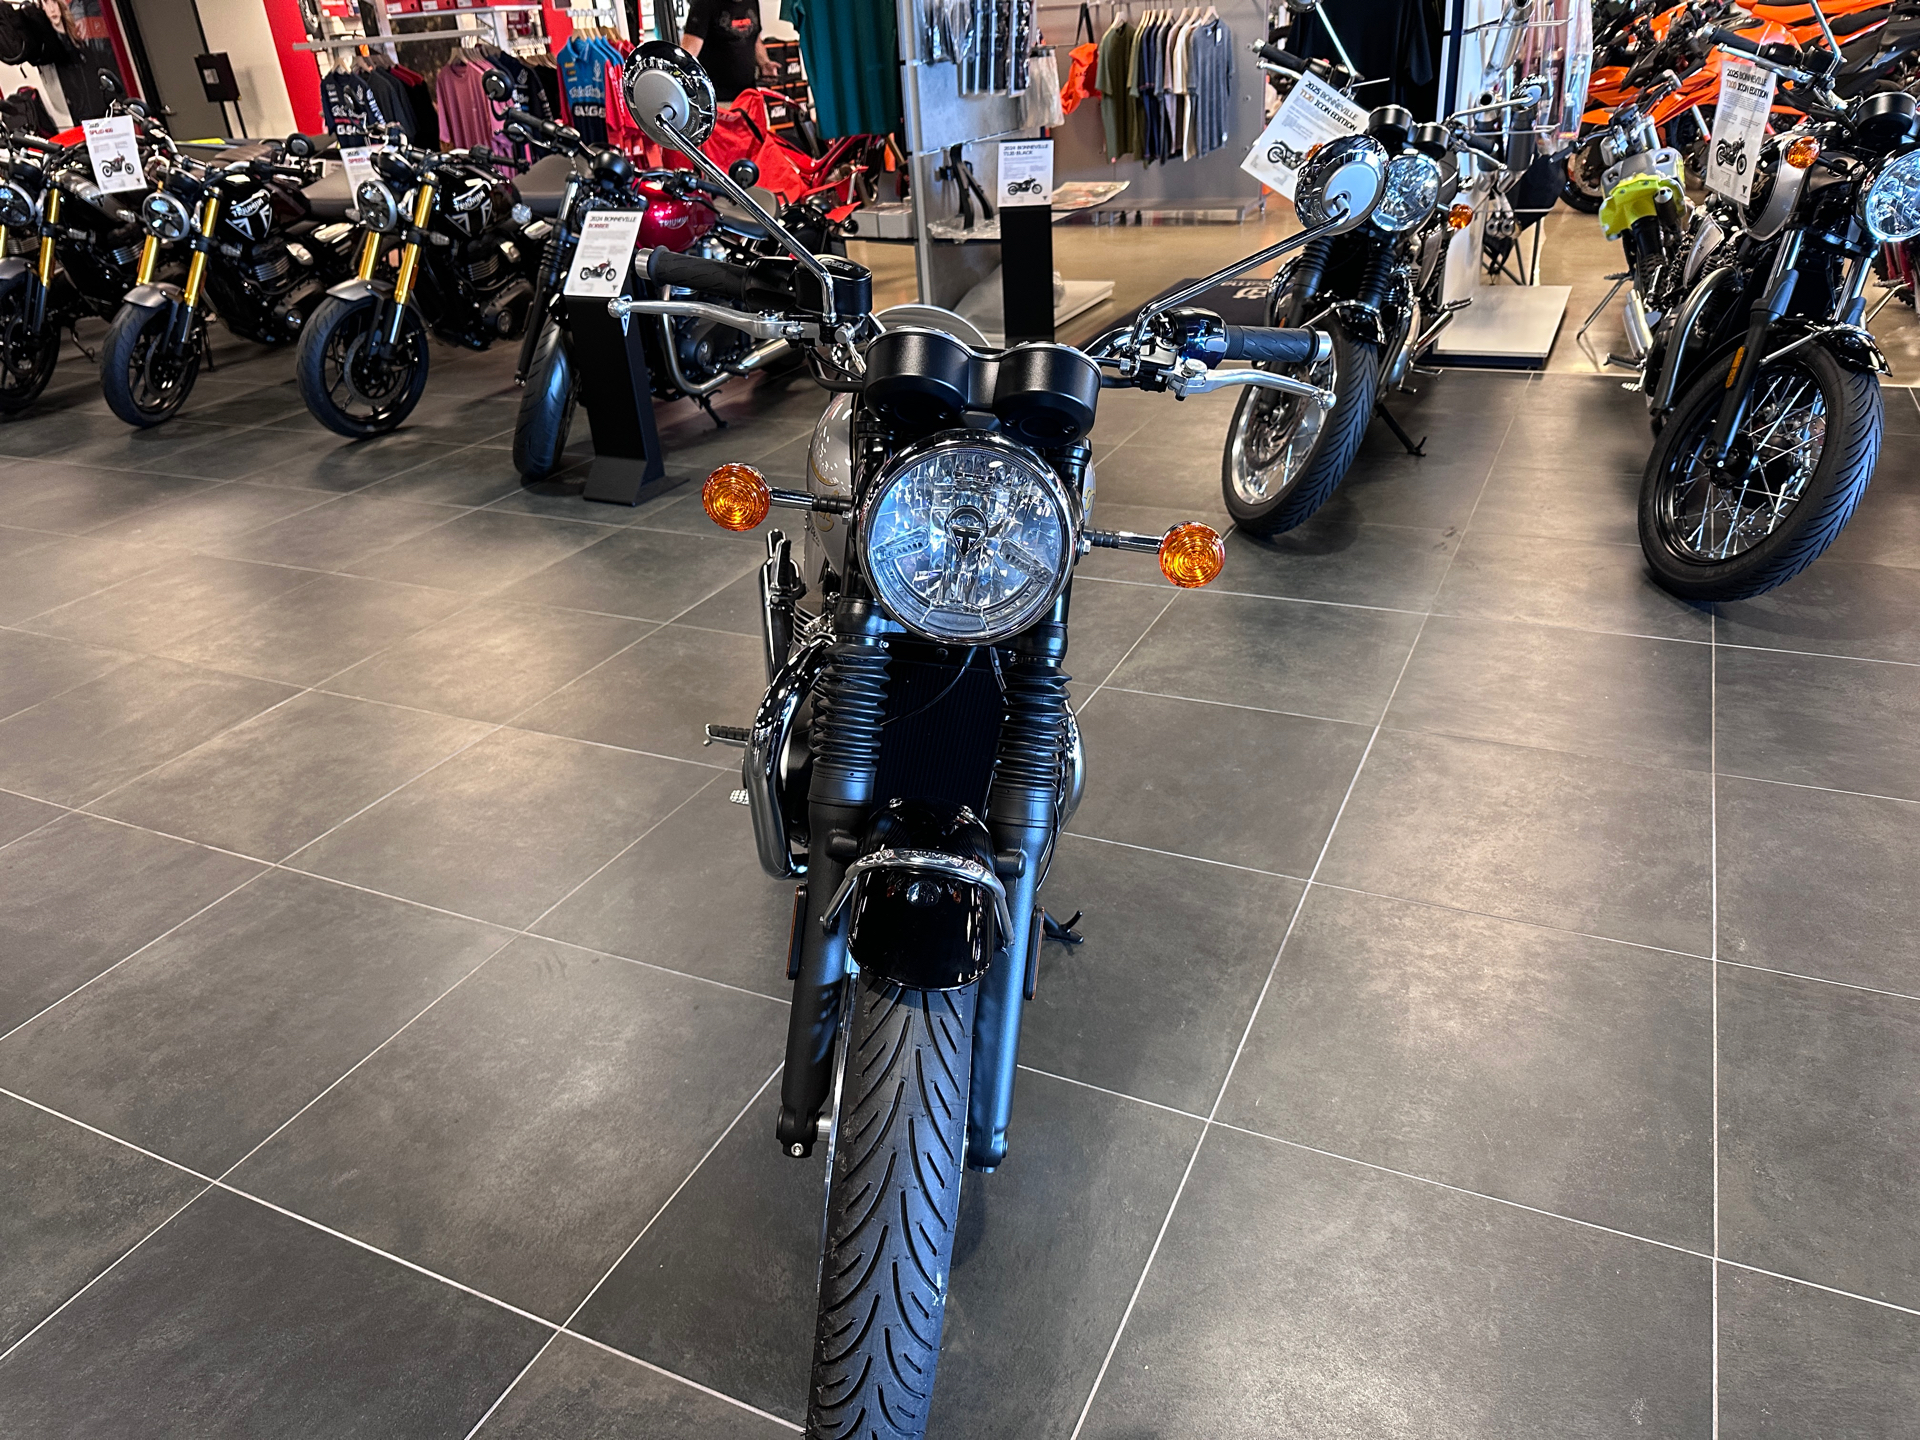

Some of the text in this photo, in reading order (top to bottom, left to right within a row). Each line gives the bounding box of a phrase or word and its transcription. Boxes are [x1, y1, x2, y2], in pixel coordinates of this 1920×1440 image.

[1727, 68, 1768, 87] 2025 BONNEVILLE
[1304, 80, 1321, 95] 2025
[1320, 91, 1359, 121] BONNEVILLE
[1737, 82, 1750, 94] ICON
[1749, 86, 1769, 100] EDITION
[1299, 88, 1358, 132] T120 ICON EDITION
[231, 197, 264, 218] TRIUMPH
[658, 215, 689, 228] TRIUMPH
[903, 849, 963, 867] TRIUMPH
